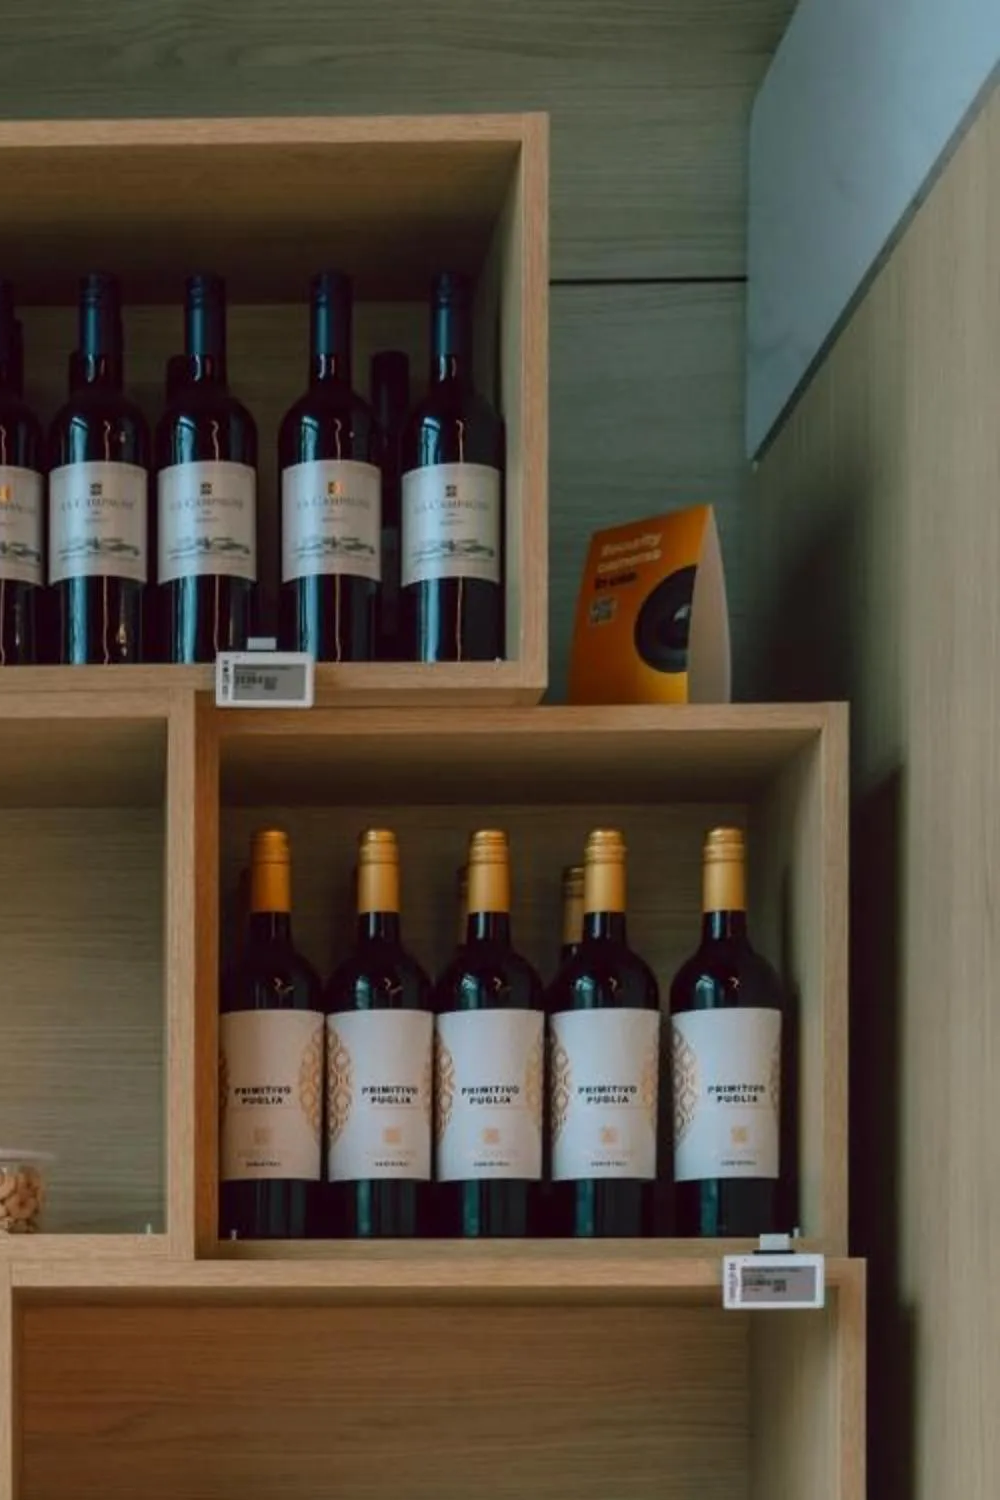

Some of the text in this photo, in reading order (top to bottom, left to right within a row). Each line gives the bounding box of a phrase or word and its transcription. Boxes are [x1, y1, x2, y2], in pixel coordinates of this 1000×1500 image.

[234, 1085, 292, 1096] PRIMITIVO
[362, 1085, 419, 1096] PRIMITIVO
[461, 1085, 520, 1096] PRIMITIVO
[578, 1085, 637, 1096] PRIMITIVO
[707, 1084, 766, 1095] PRIMITIVO
[241, 1096, 284, 1105] PUGLIA
[371, 1095, 412, 1105] PUGLIA
[469, 1095, 511, 1105] PUGLIA
[586, 1095, 629, 1105] PUGLIA
[717, 1094, 758, 1104] PUGLIA
